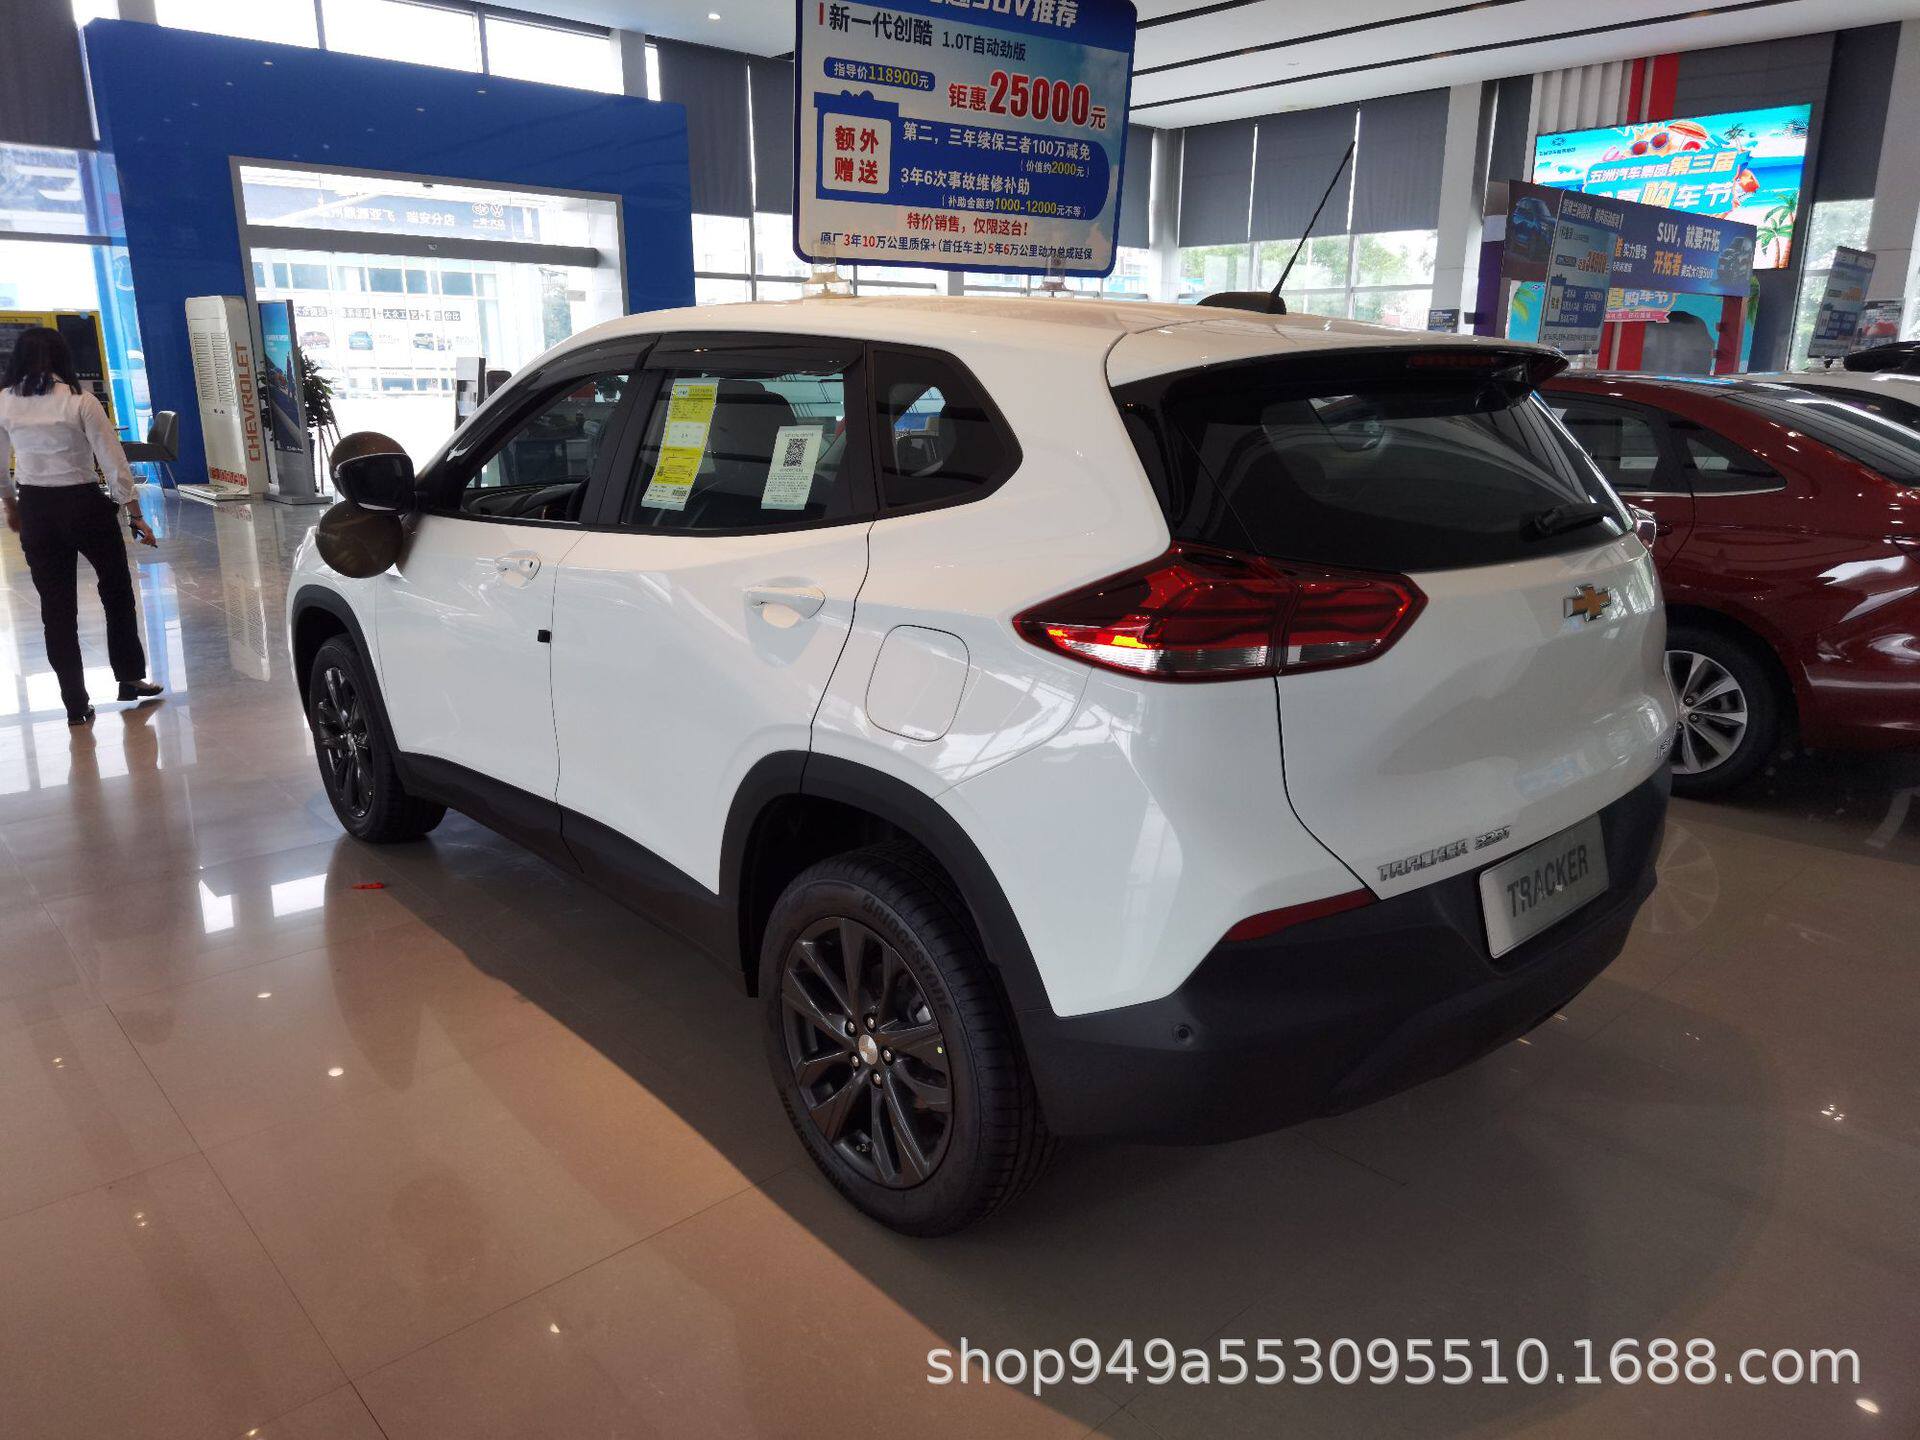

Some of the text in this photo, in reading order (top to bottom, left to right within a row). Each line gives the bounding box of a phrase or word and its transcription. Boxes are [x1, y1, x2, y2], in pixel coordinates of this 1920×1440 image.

[829, 4, 1026, 61] 新一代创酷 1.0T自动劲版
[834, 62, 929, 88] 指导价118900元
[834, 125, 879, 154] 额外
[834, 157, 878, 184] 赠送
[901, 167, 1030, 195] 3年6次事故维修补助
[1653, 250, 1683, 277] 开拓者
[234, 341, 261, 462] CHEVROLET
[1377, 839, 1469, 882] TRACKER
[1506, 844, 1589, 917] TRACKER
